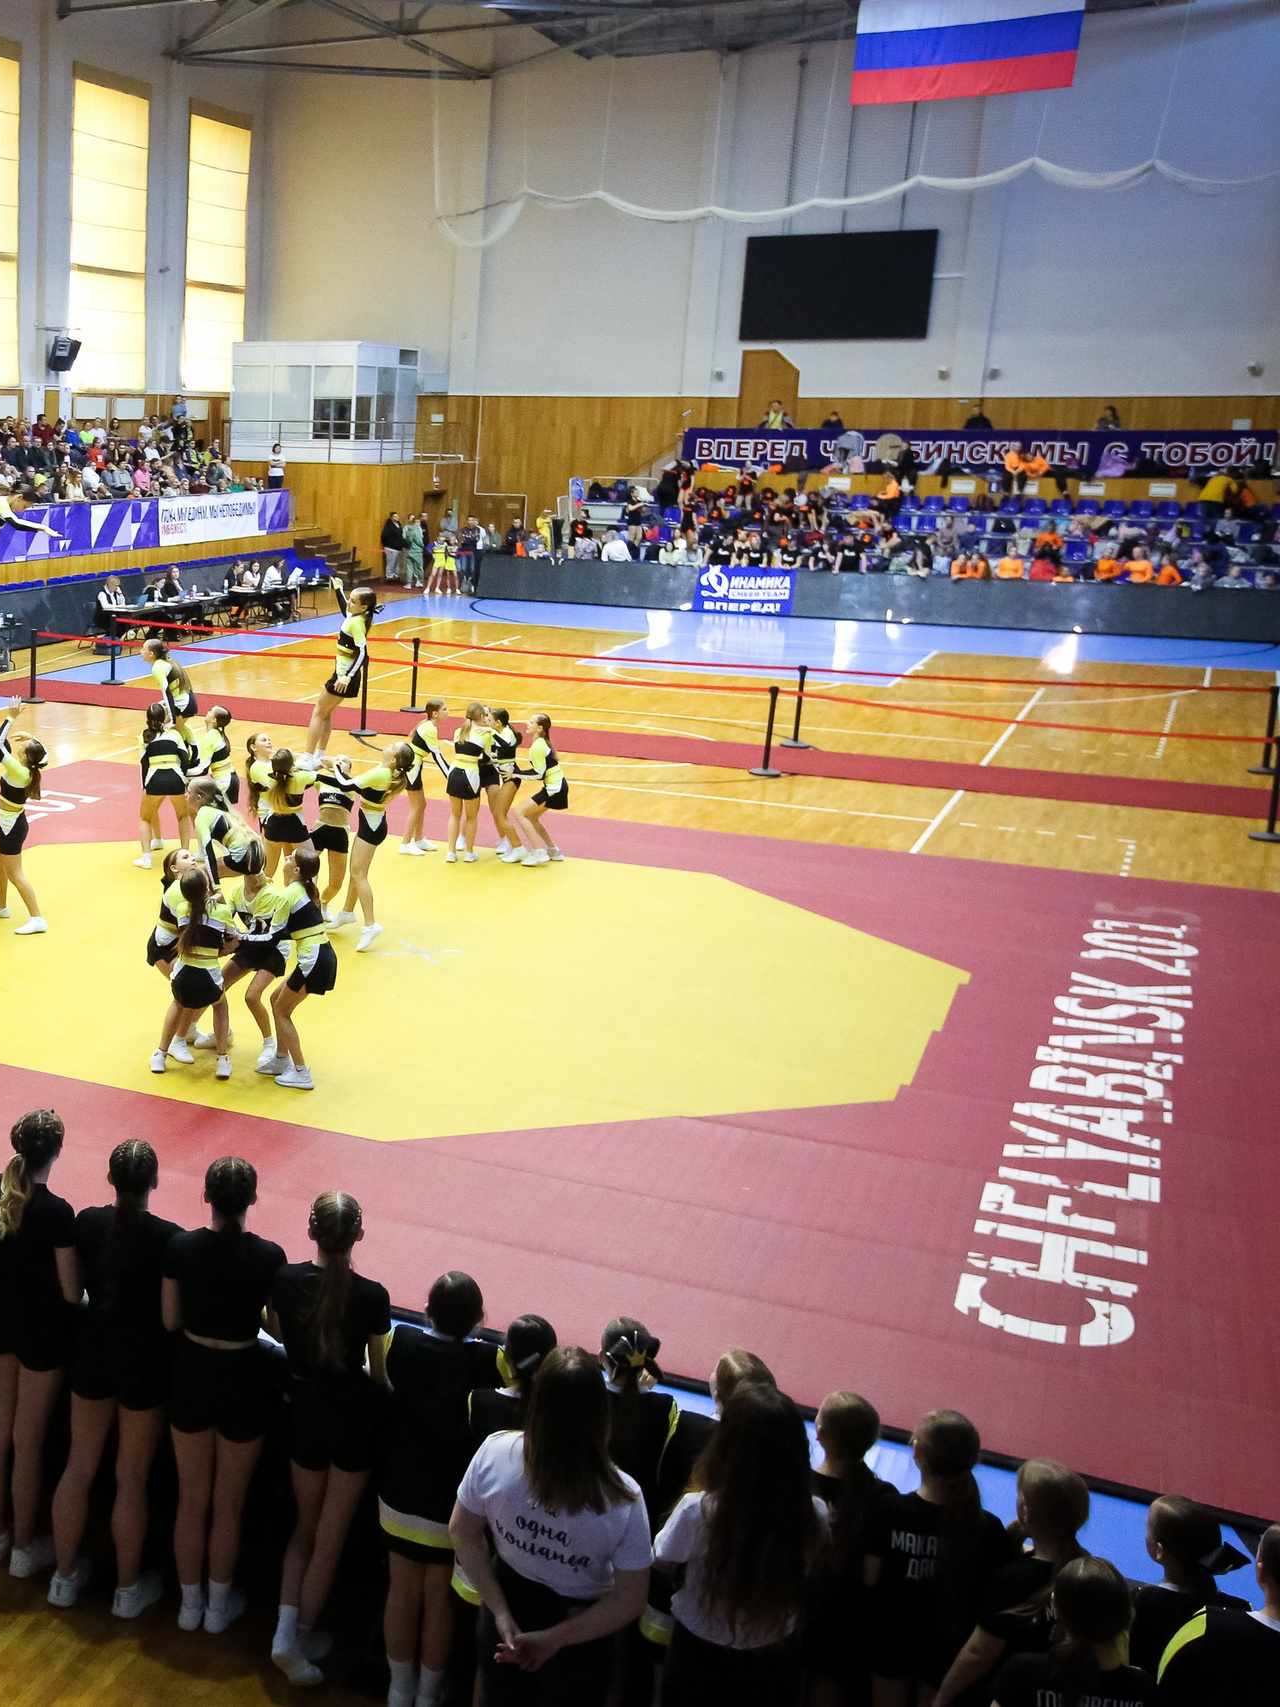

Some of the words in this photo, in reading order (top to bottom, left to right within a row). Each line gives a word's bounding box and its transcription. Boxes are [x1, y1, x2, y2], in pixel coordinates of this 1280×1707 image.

[695, 438, 807, 462] ВПЕРЕД
[703, 600, 781, 613] ВПЕРЁД!
[515, 1514, 572, 1548] одна
